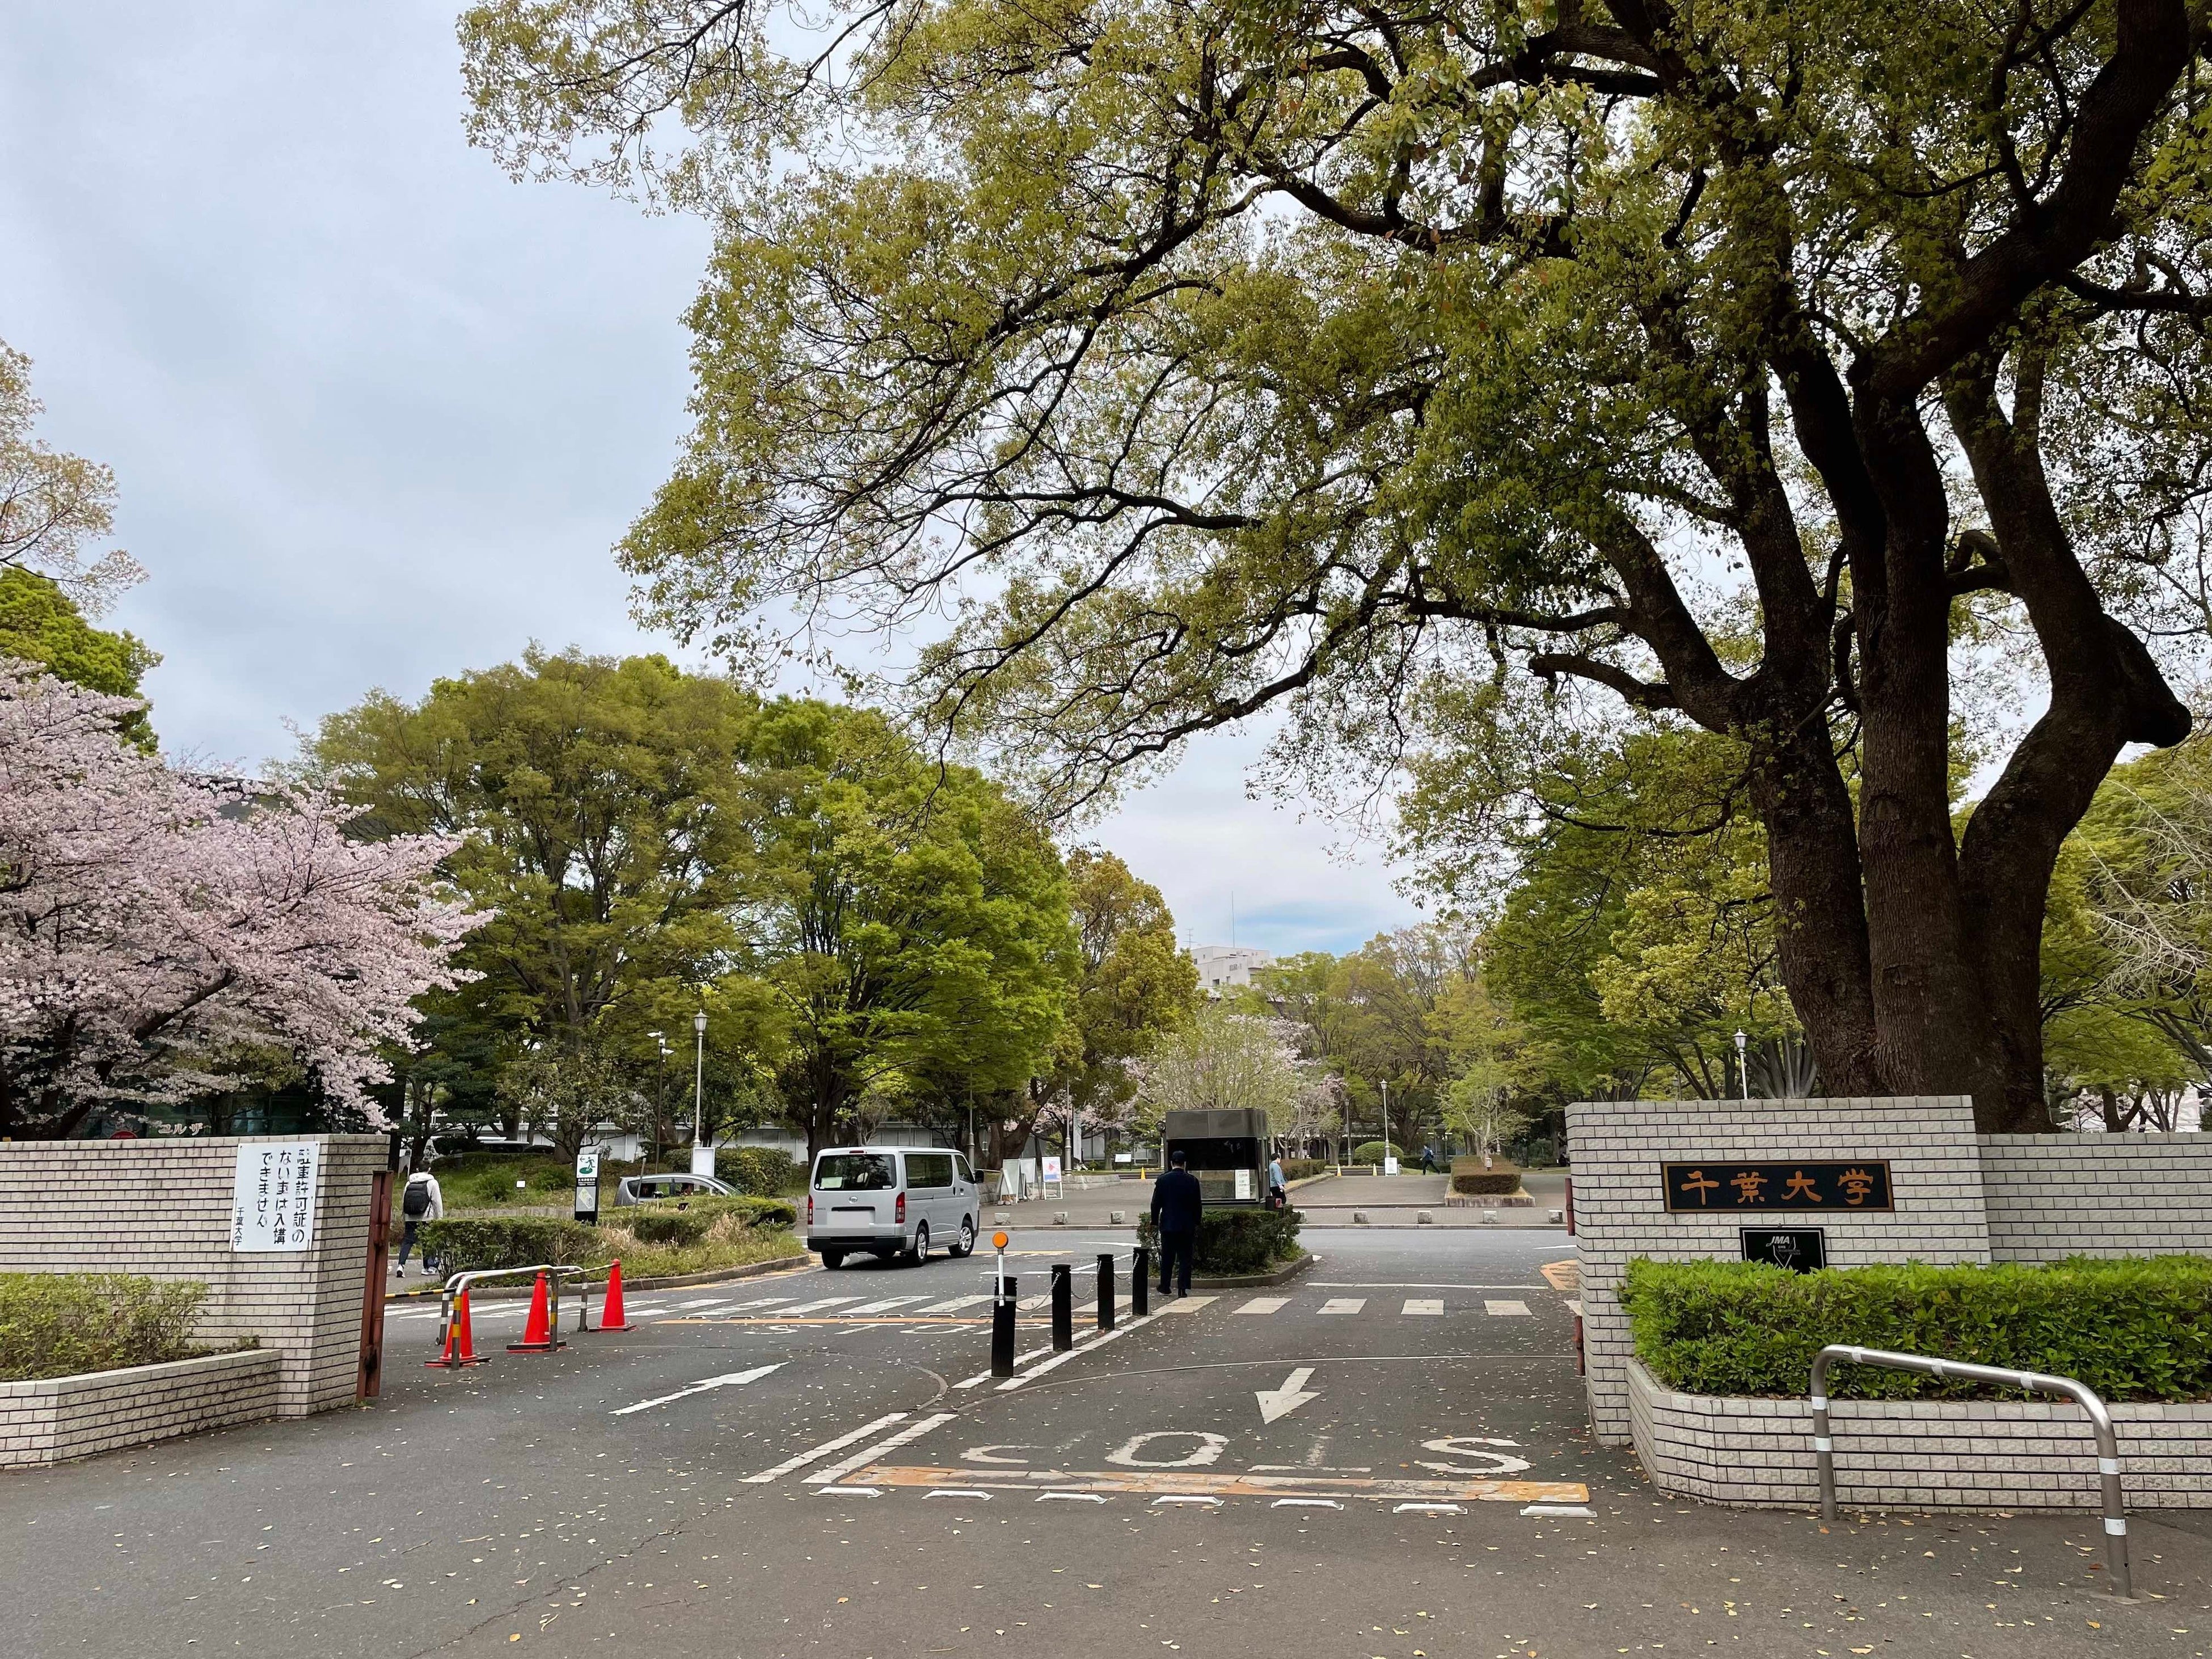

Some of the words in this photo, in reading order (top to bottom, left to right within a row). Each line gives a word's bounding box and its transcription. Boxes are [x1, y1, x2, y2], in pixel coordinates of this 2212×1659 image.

[257, 1153, 272, 1227] できません
[1681, 1168, 1873, 1205] 千葉大学
[234, 1207, 244, 1246] 千葉大学
[1766, 1236, 1790, 1247] JMA
